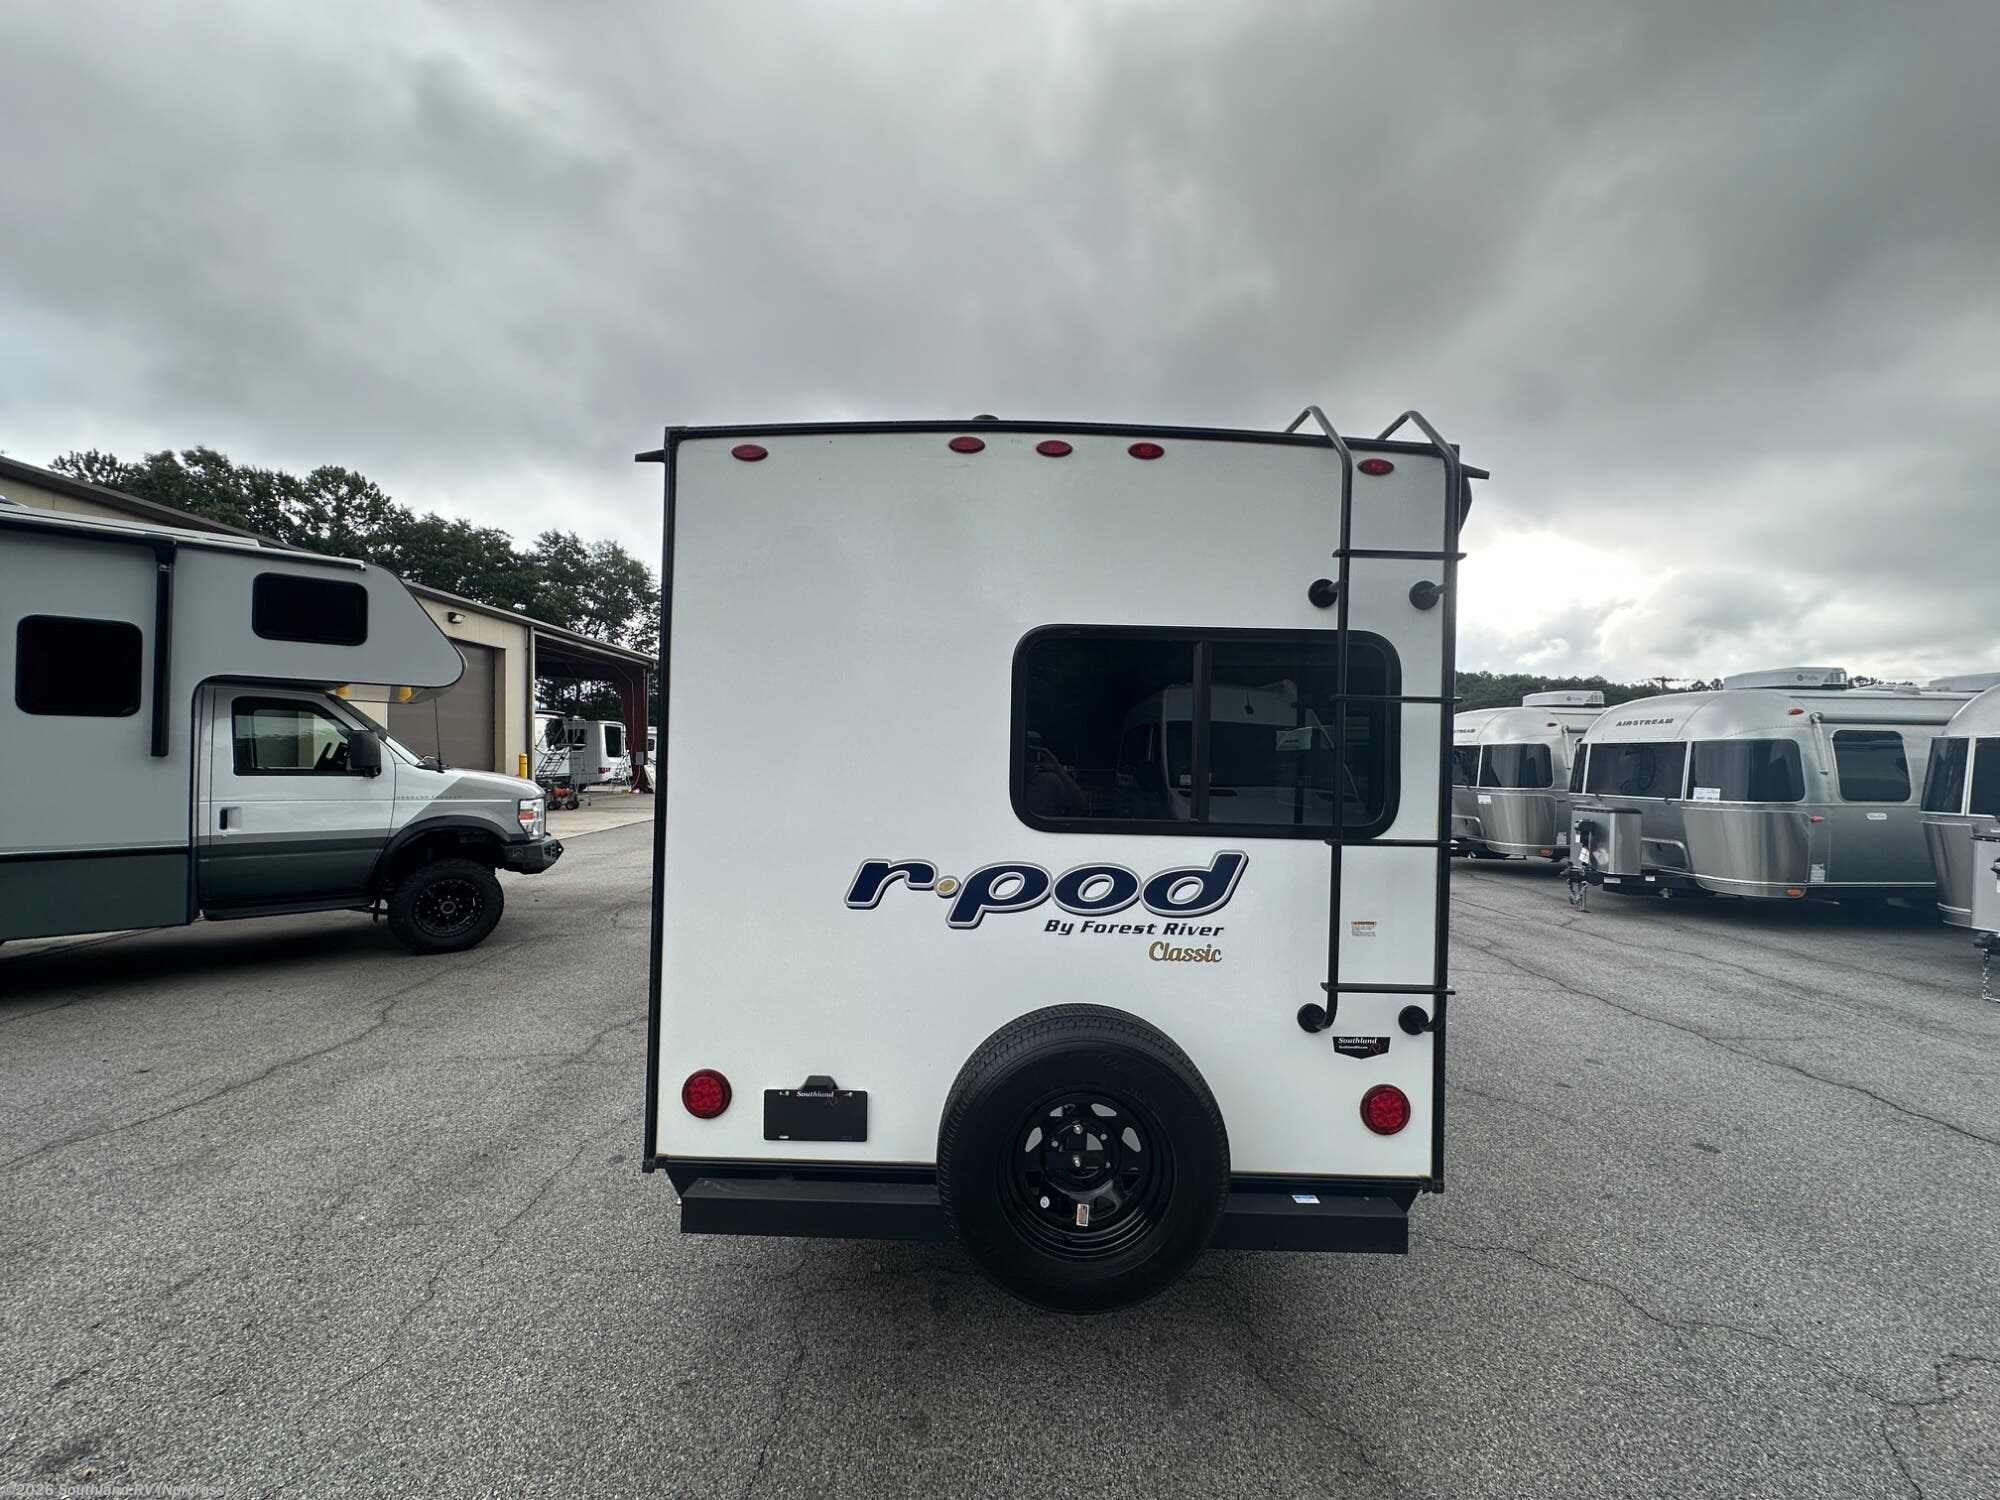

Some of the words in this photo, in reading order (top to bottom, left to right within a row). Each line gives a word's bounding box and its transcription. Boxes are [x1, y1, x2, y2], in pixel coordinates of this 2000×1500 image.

[1616, 718, 1674, 727] AIRSTREAM
[1044, 919, 1074, 936] By
[1080, 920, 1157, 935] Forest
[1162, 922, 1225, 937] River
[1148, 940, 1223, 963] Classic
[796, 1090, 834, 1098] Southland
